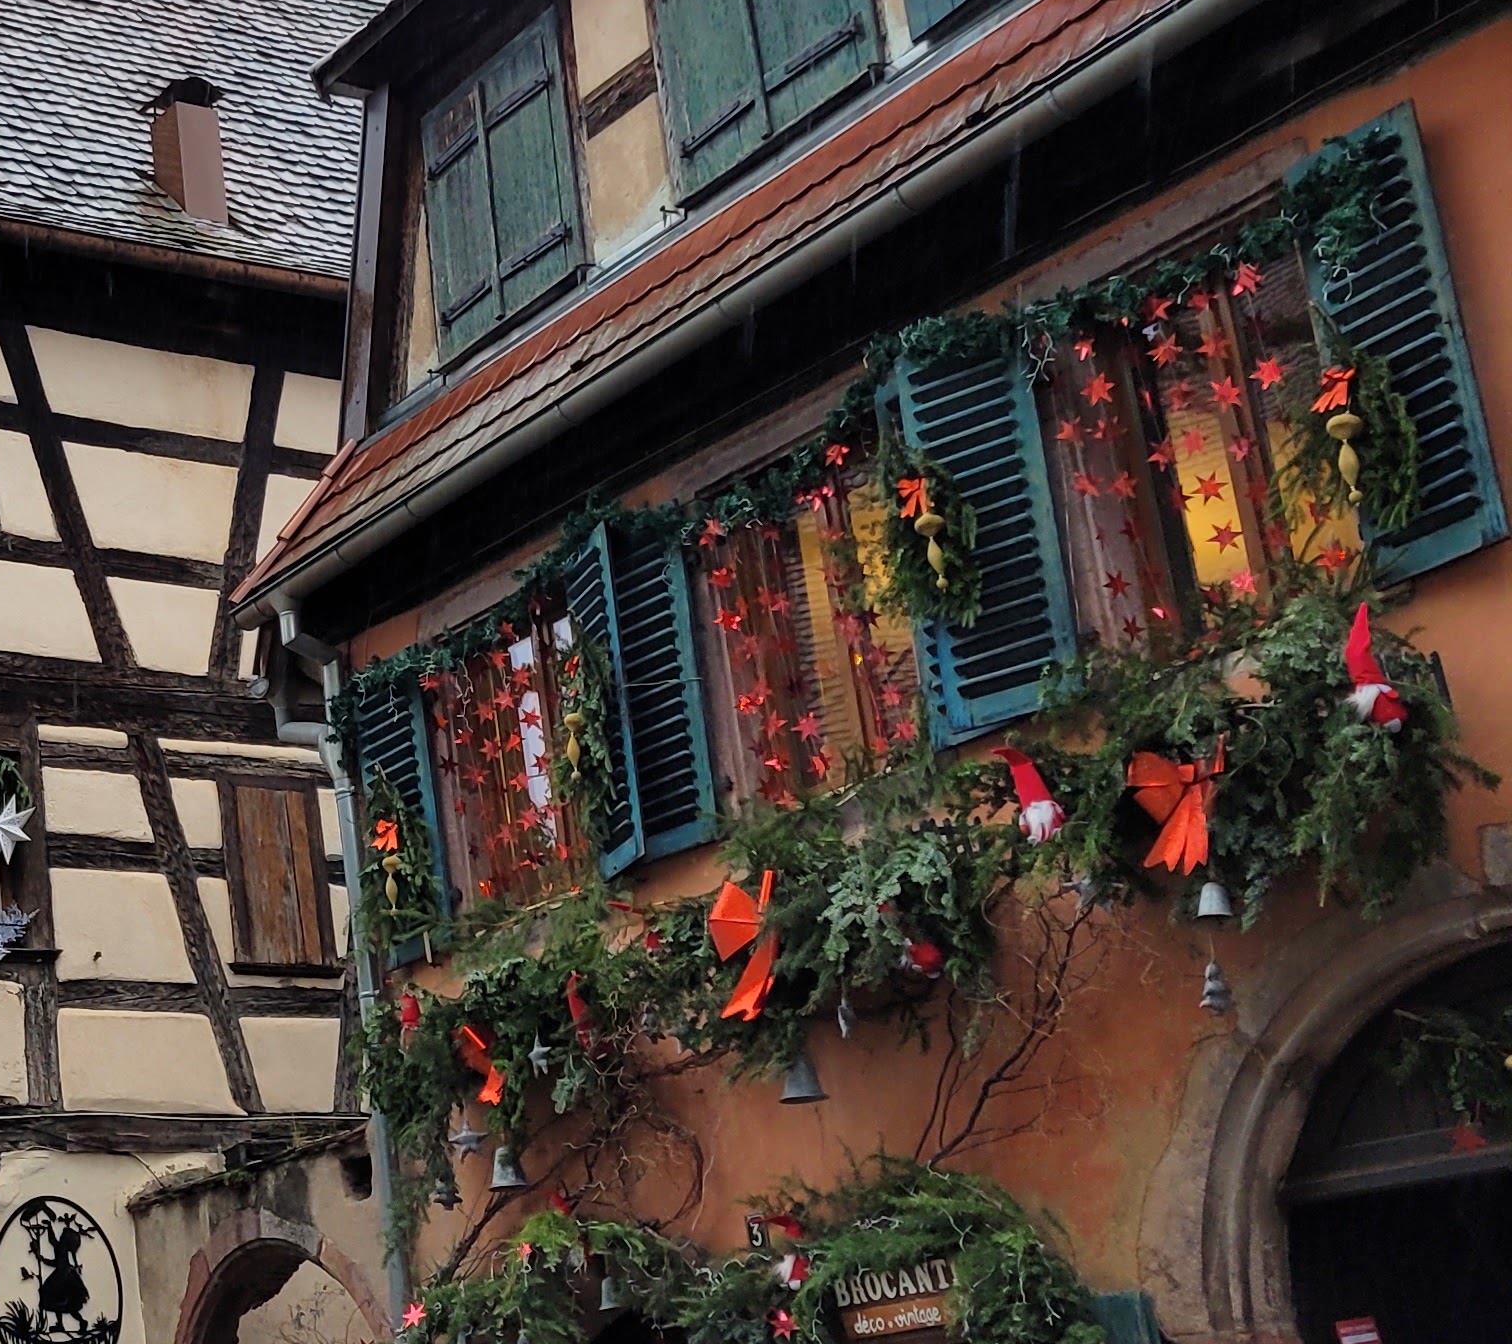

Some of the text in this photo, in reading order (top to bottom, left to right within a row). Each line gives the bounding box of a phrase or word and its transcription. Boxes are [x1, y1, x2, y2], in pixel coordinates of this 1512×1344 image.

[749, 1222, 763, 1247] 3
[853, 1304, 942, 1334] déco vintage
